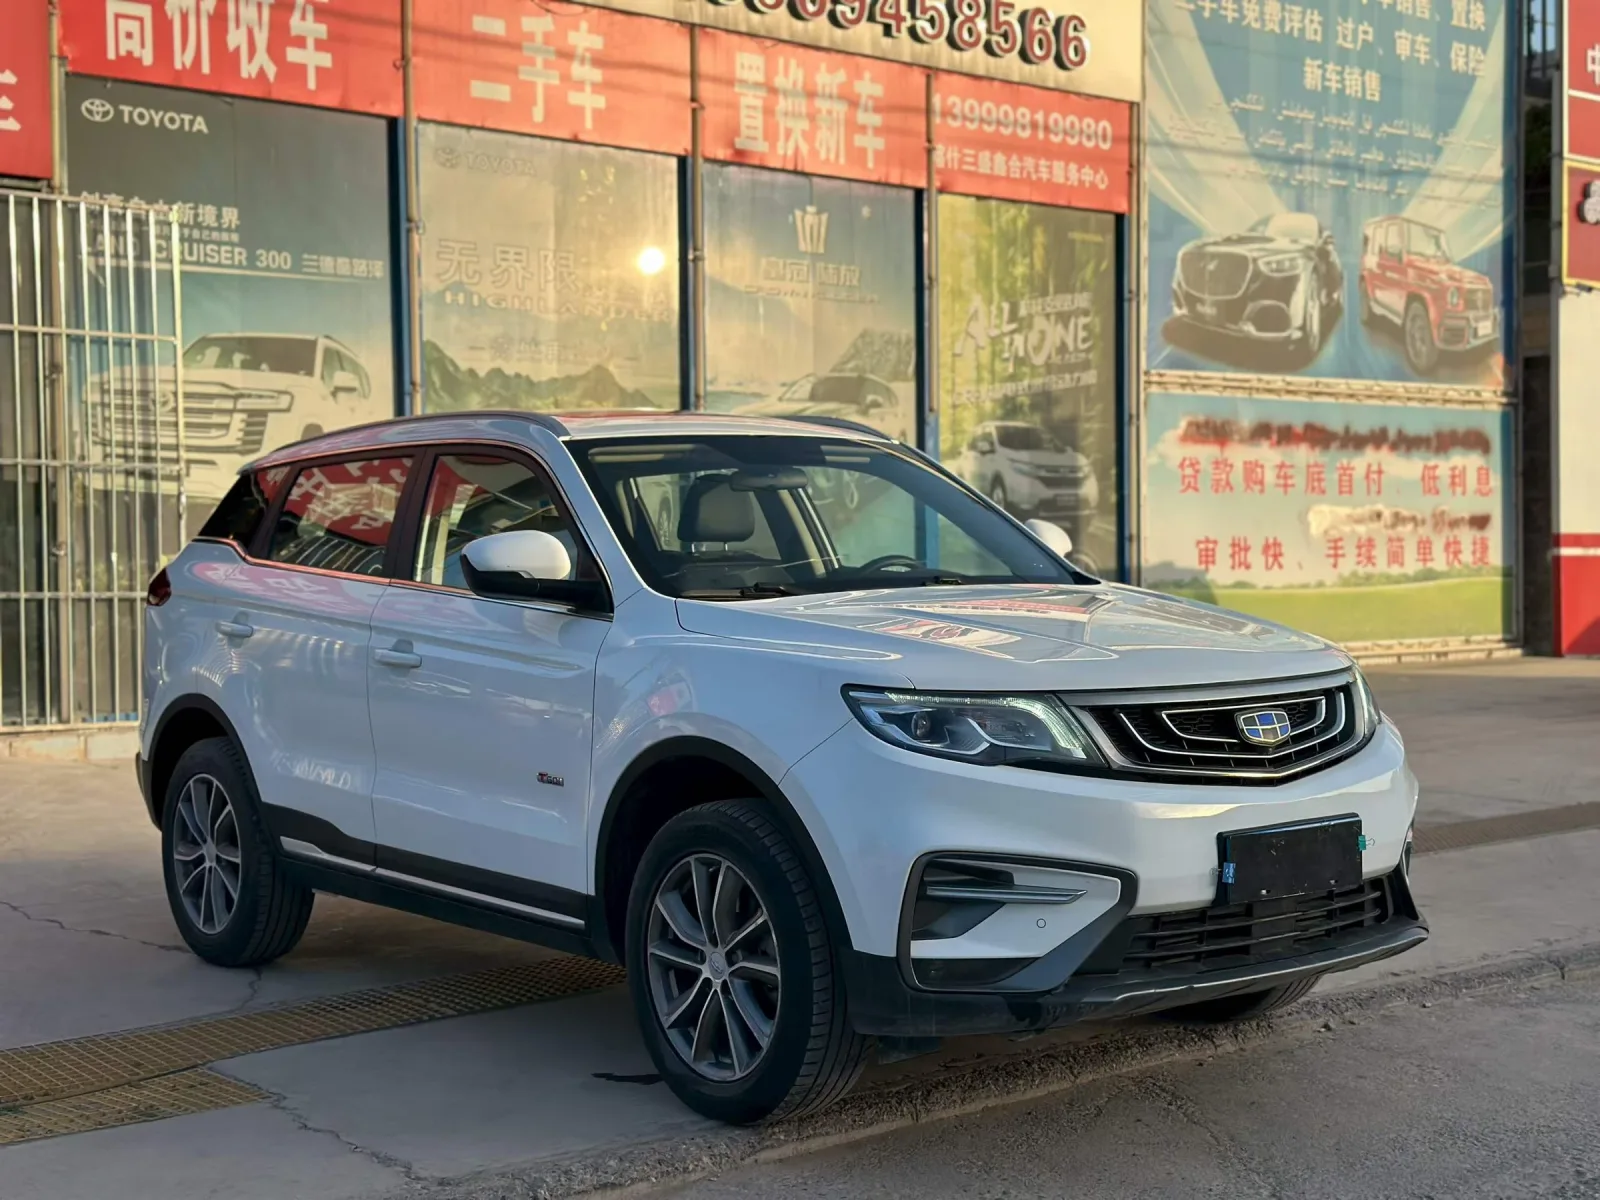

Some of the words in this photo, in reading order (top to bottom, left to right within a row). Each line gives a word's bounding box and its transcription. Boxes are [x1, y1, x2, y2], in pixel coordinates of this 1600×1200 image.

[470, 15, 606, 130] 二手车
[1304, 57, 1381, 102] 新车销售
[119, 105, 209, 134] TOYOTA
[734, 51, 885, 169] 置换新车
[933, 93, 1112, 150] 13999819980
[255, 248, 292, 270] 300
[1027, 313, 1094, 366] ONE
